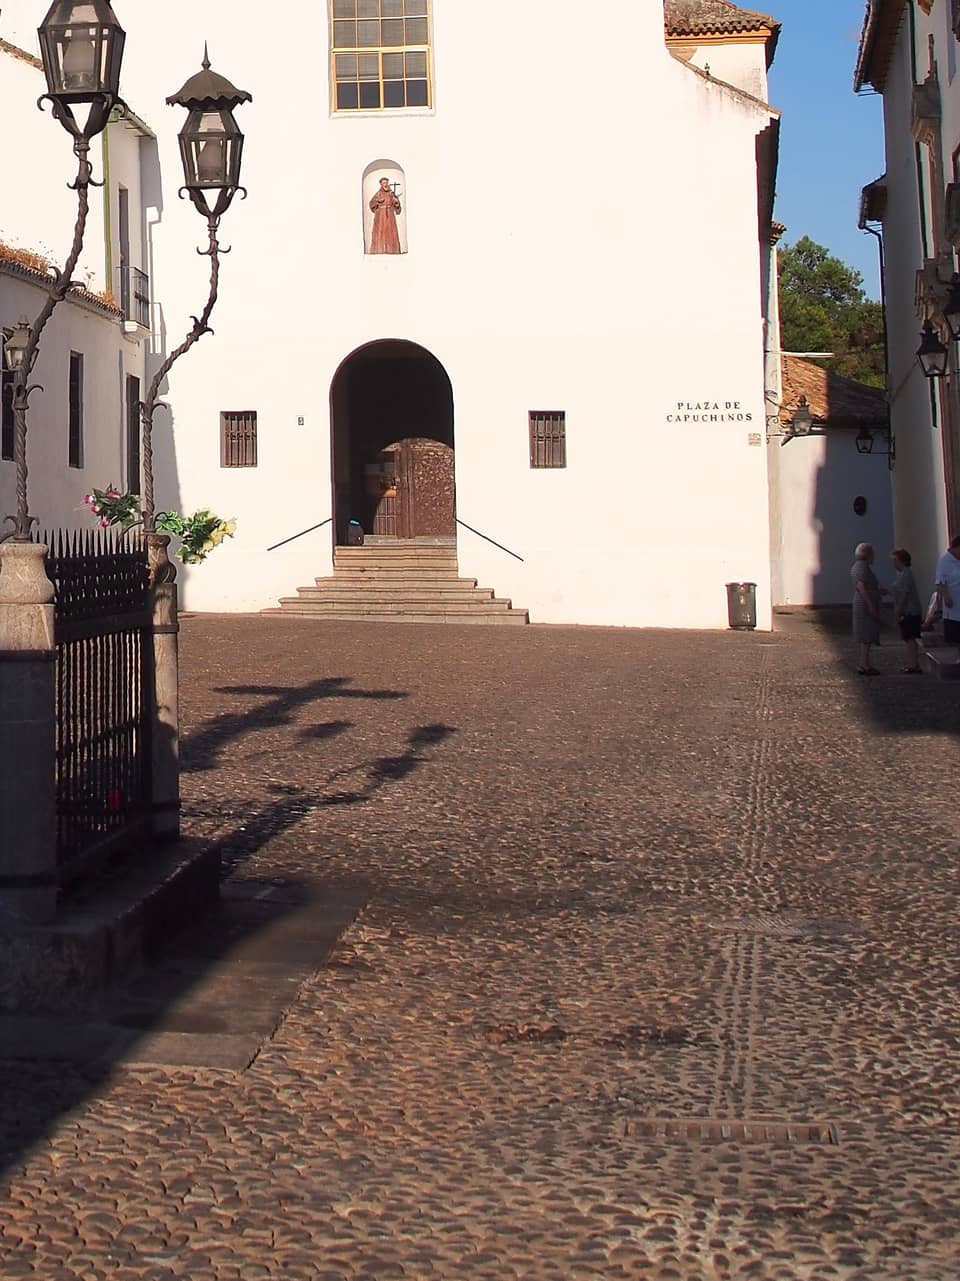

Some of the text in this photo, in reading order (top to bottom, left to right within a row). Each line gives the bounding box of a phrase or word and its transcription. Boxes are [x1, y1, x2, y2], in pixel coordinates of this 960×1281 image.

[677, 401, 741, 411] PLAZA DE
[666, 412, 753, 423] CAPUCHINOS
